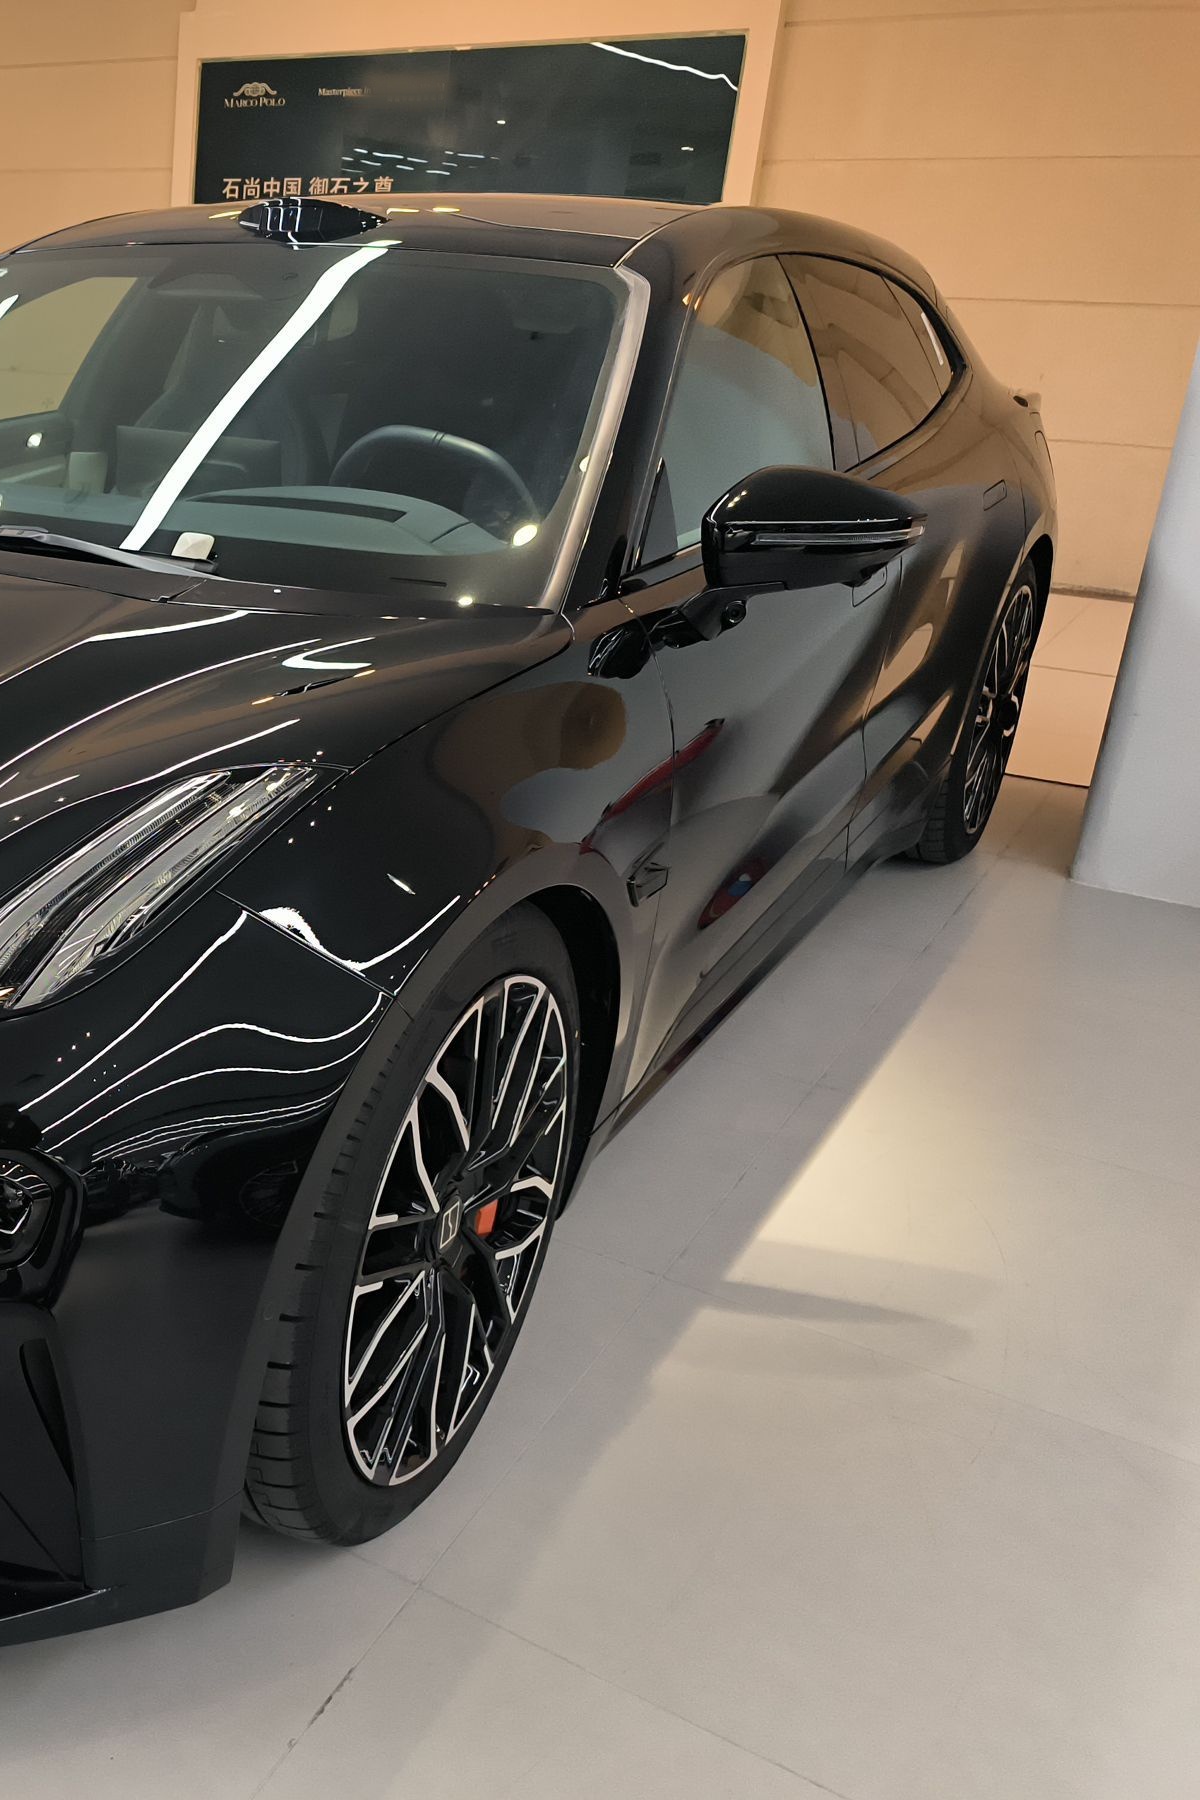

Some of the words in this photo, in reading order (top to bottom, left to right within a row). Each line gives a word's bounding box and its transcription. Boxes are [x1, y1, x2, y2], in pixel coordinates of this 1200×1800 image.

[259, 97, 286, 107] POLO
[222, 177, 301, 199] 石尚中国
